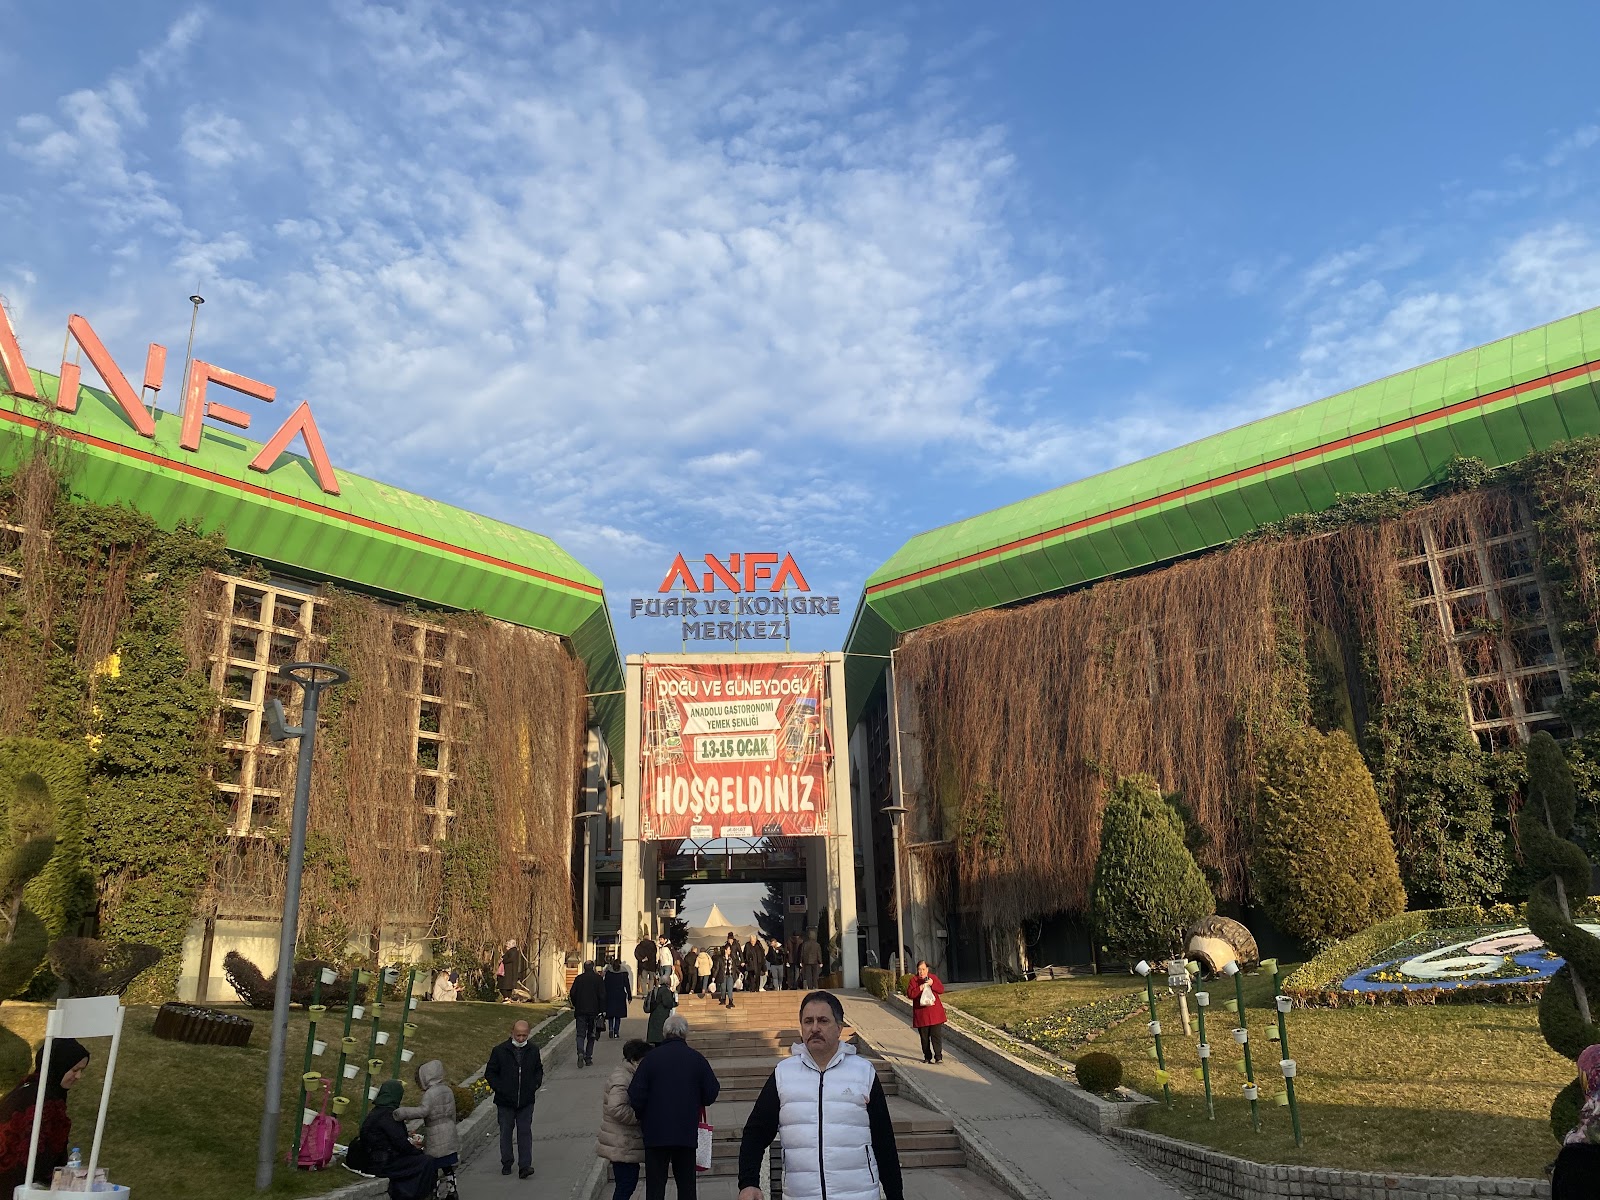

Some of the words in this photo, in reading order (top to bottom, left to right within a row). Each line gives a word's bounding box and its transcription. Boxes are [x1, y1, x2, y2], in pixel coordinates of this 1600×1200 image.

[658, 551, 811, 593] ANFA
[630, 597, 699, 619] FUAR
[703, 599, 731, 615] ve
[738, 596, 841, 616] KONGRE
[682, 616, 791, 642] MERKEZİ
[658, 676, 698, 697] DOĞU
[701, 680, 722, 697] VE
[725, 675, 810, 696] GÜNEYDOĞU
[690, 705, 723, 718] ANADOLU
[724, 700, 774, 715] GASTORONOMİ
[706, 718, 731, 730] YEMEK
[732, 714, 759, 730] ŞENLİĞİ
[701, 739, 734, 759] 13-15
[736, 738, 769, 757] OCAK
[656, 764, 815, 823] HOŞGELDİNİZ
[662, 900, 671, 909] A
[794, 896, 802, 905] B
